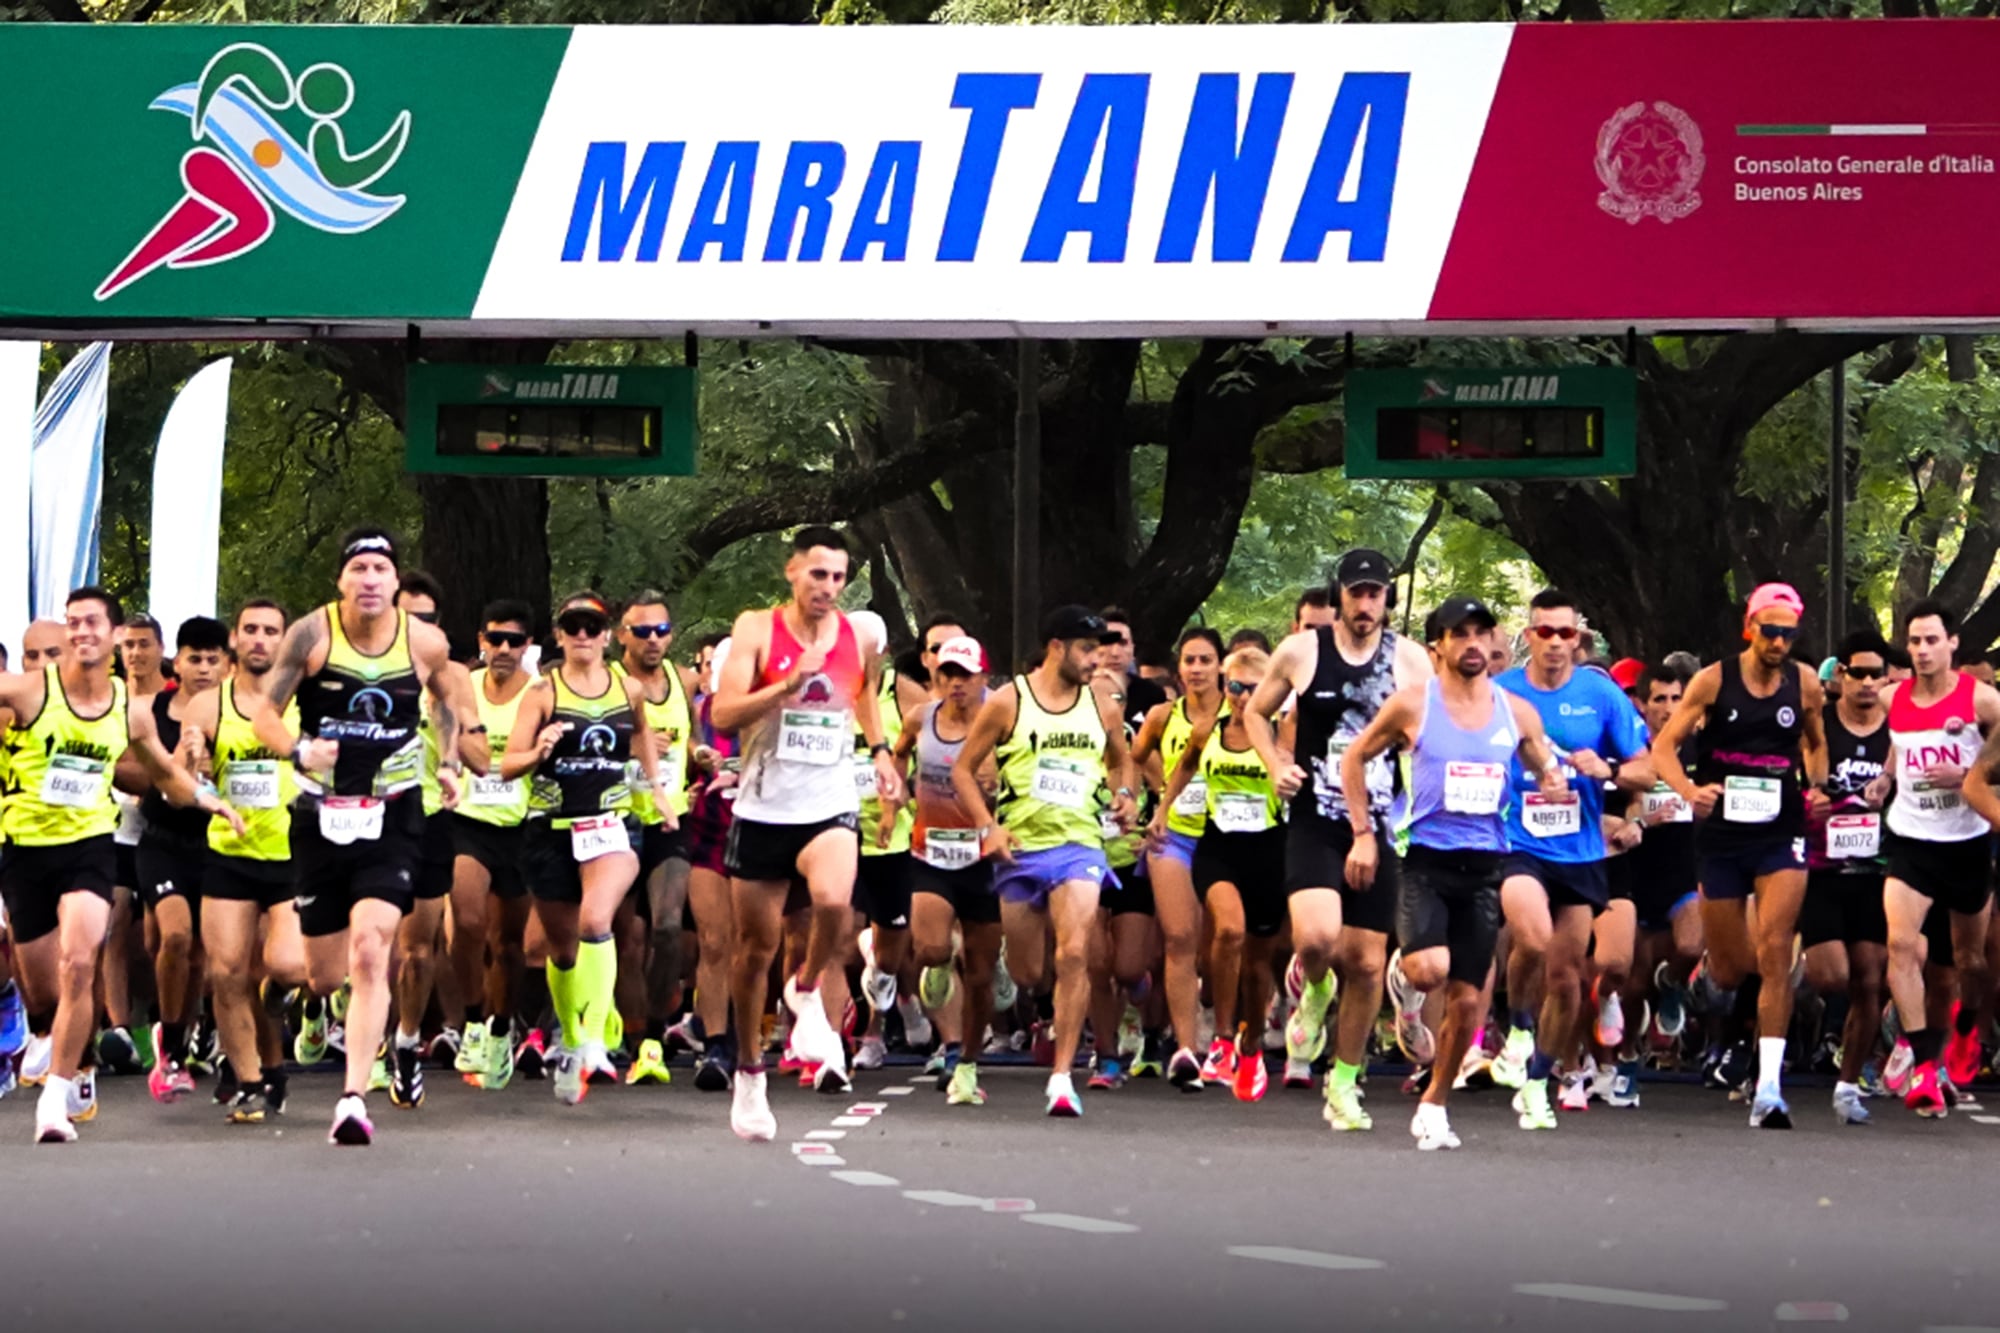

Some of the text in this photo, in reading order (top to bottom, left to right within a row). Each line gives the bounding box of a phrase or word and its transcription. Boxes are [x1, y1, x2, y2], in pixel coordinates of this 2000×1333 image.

[561, 72, 1411, 262] MARATANA
[1734, 154, 1994, 174] Consolato Generale d'Italia
[1735, 183, 1862, 201] Buenos Aires
[515, 373, 620, 399] MARATANA
[1455, 375, 1559, 401] MARATANA
[787, 731, 833, 751] B4296
[1905, 743, 1961, 772] ADN
[1834, 832, 1874, 849] A0072
